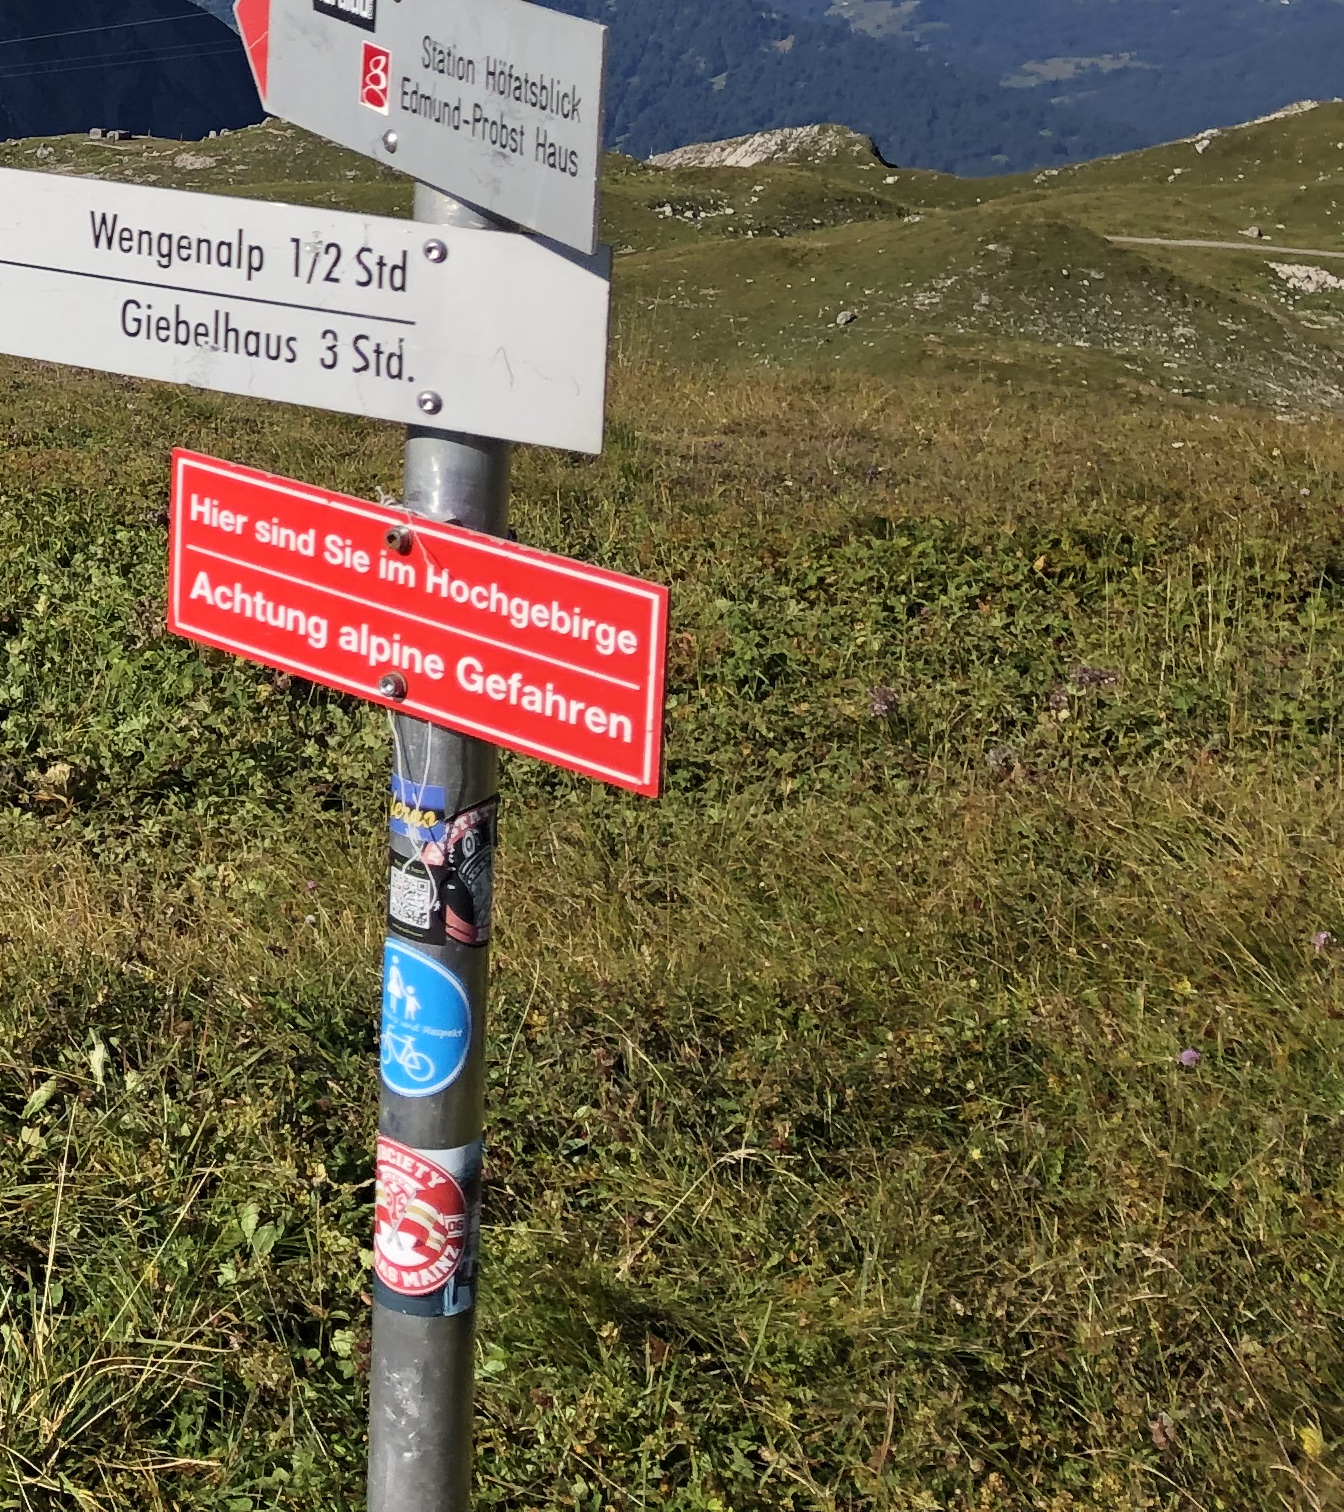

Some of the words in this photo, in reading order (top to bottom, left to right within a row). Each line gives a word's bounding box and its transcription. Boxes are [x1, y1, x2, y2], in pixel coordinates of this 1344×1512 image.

[423, 35, 474, 83] Station
[486, 56, 581, 120] Höfatsblick
[401, 77, 524, 155] Edmund-Probst
[536, 127, 578, 177] Haus
[91, 211, 263, 281] Wengenalp
[291, 238, 341, 284] 1/2
[356, 247, 407, 292] Std
[122, 300, 296, 363] Giebelhaus
[321, 330, 337, 369] 3
[353, 334, 414, 382] Std.
[191, 494, 248, 534] Hier
[255, 518, 315, 556] sind
[324, 534, 370, 573] Sie
[380, 550, 415, 587] im
[425, 567, 637, 654] Hochgebirge
[190, 572, 327, 648] Achtung
[339, 624, 444, 679] alpine
[457, 657, 632, 743] Gefahren
[401, 1245, 460, 1288] MAINZ
